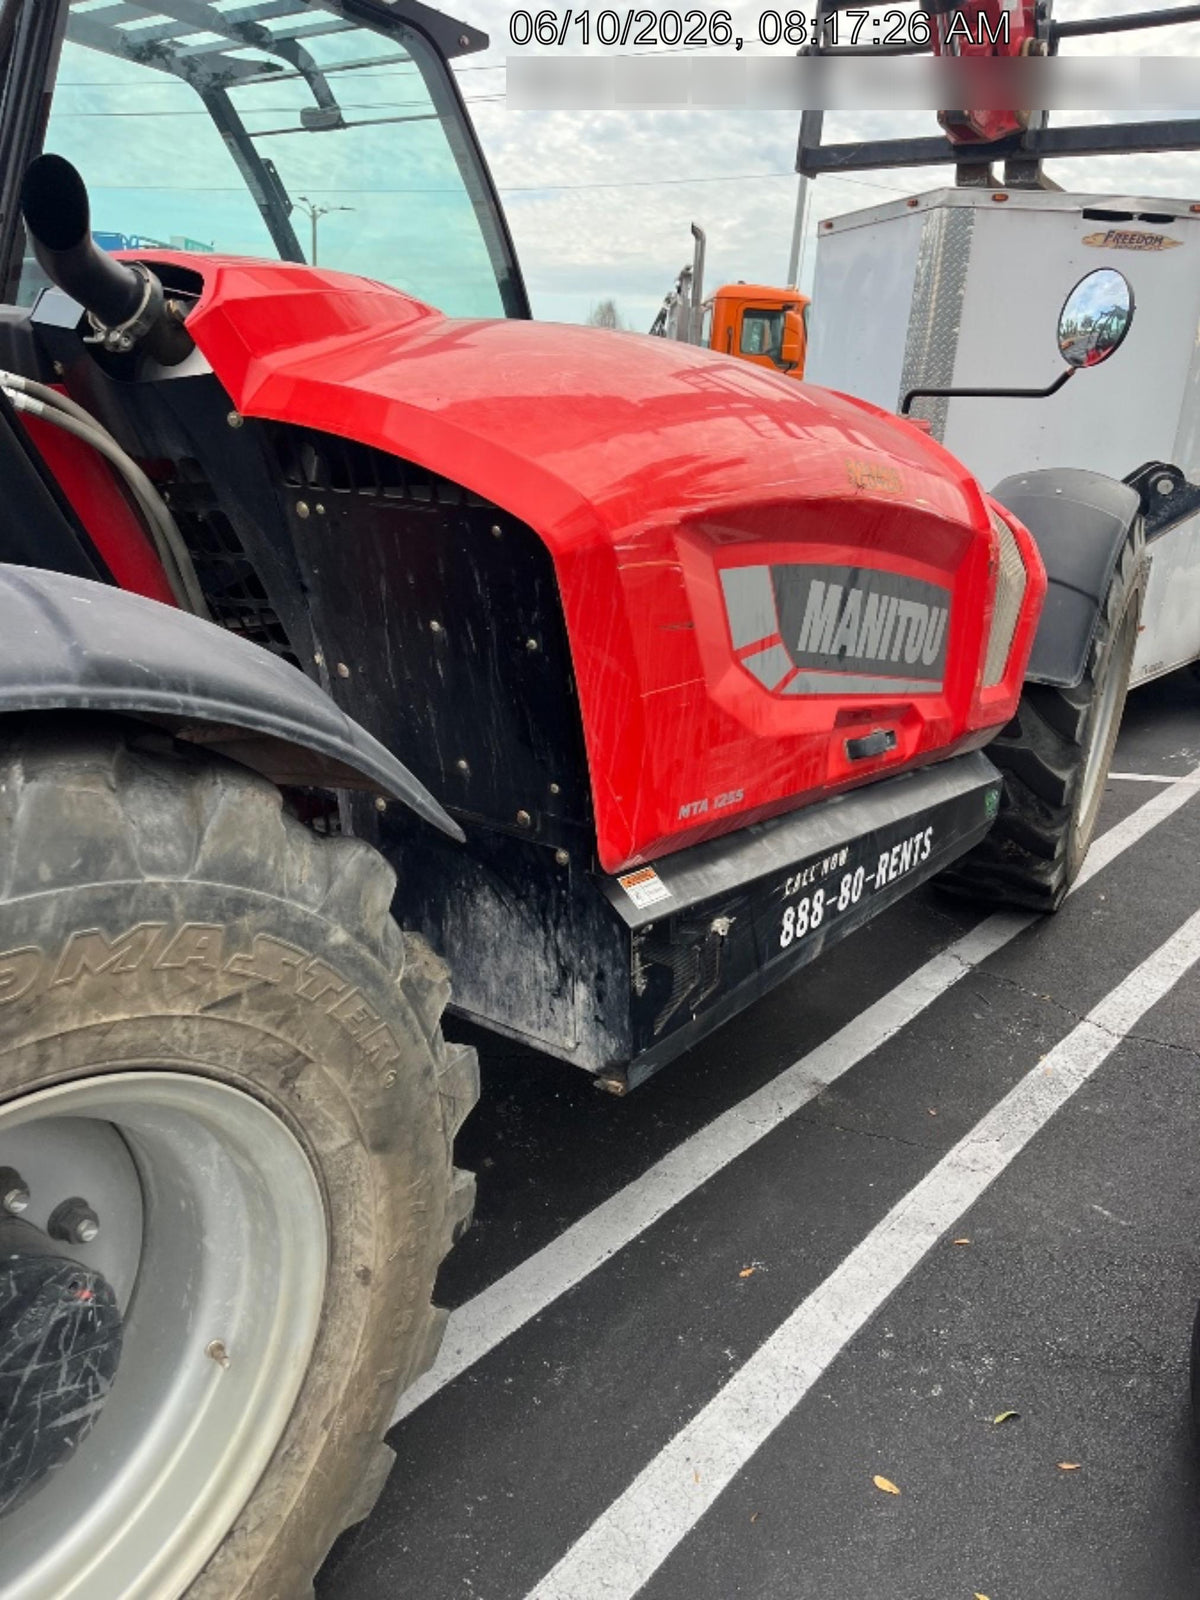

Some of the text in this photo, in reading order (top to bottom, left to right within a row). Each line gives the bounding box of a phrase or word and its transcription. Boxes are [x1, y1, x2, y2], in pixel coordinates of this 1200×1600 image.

[1103, 229, 1164, 246] FREEDOM
[797, 578, 949, 667] MANITOU
[678, 798, 709, 820] MTA
[779, 826, 933, 948] 888-80-RENTS
